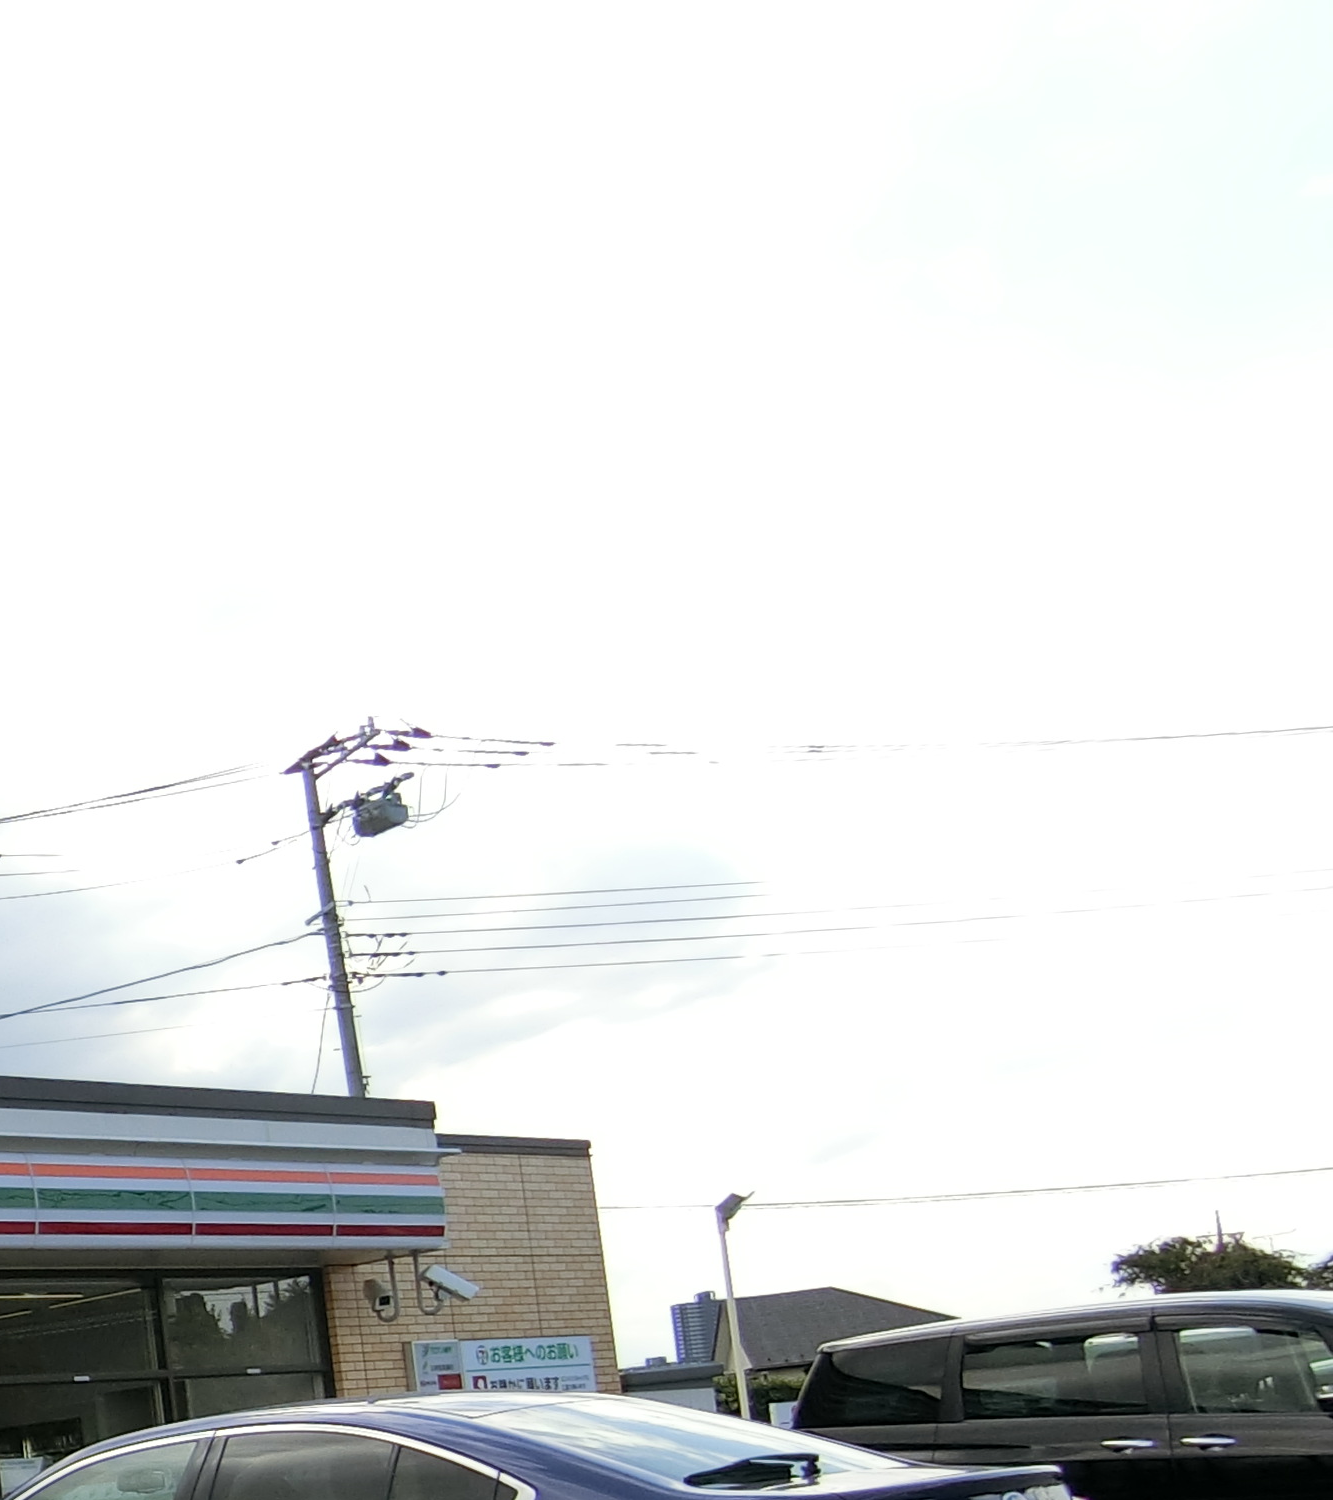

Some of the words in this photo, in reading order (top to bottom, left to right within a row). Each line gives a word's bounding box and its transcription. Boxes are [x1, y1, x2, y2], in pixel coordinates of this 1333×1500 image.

[490, 1343, 579, 1363] お客様へのお願い
